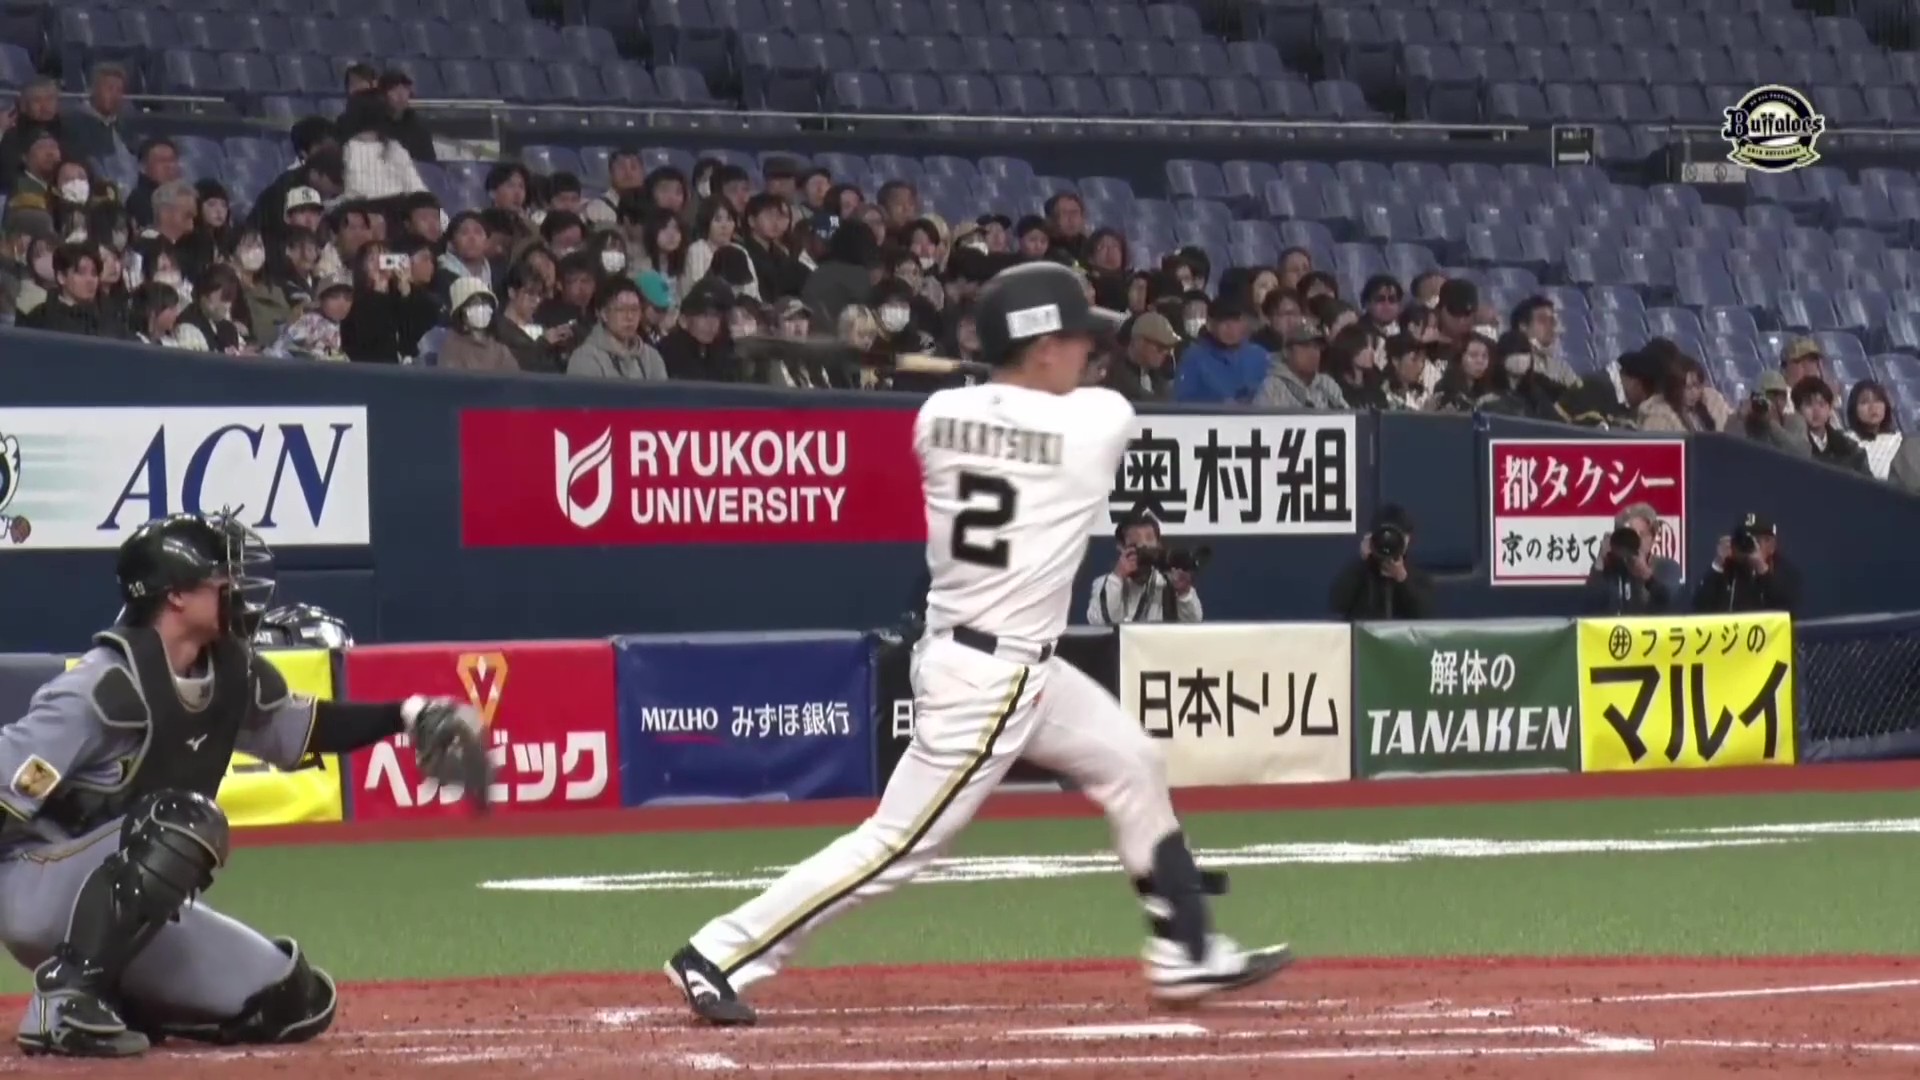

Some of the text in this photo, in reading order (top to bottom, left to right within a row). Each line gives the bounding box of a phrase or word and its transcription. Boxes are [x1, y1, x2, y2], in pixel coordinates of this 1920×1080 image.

[97, 423, 353, 529] ACN
[630, 430, 846, 477] RYUKOKU
[1108, 428, 1352, 523] 奥村組
[631, 486, 846, 524] UNIVERSITY
[1501, 455, 1675, 511] 都タクシー
[951, 471, 1020, 569] 2
[1430, 649, 1515, 695] 解体の
[641, 701, 850, 738] MIZUHO みずほ銀行
[1140, 667, 1338, 738] 日本トリム
[1367, 705, 1573, 755] TANAKEN
[1590, 660, 1788, 764] マルイ
